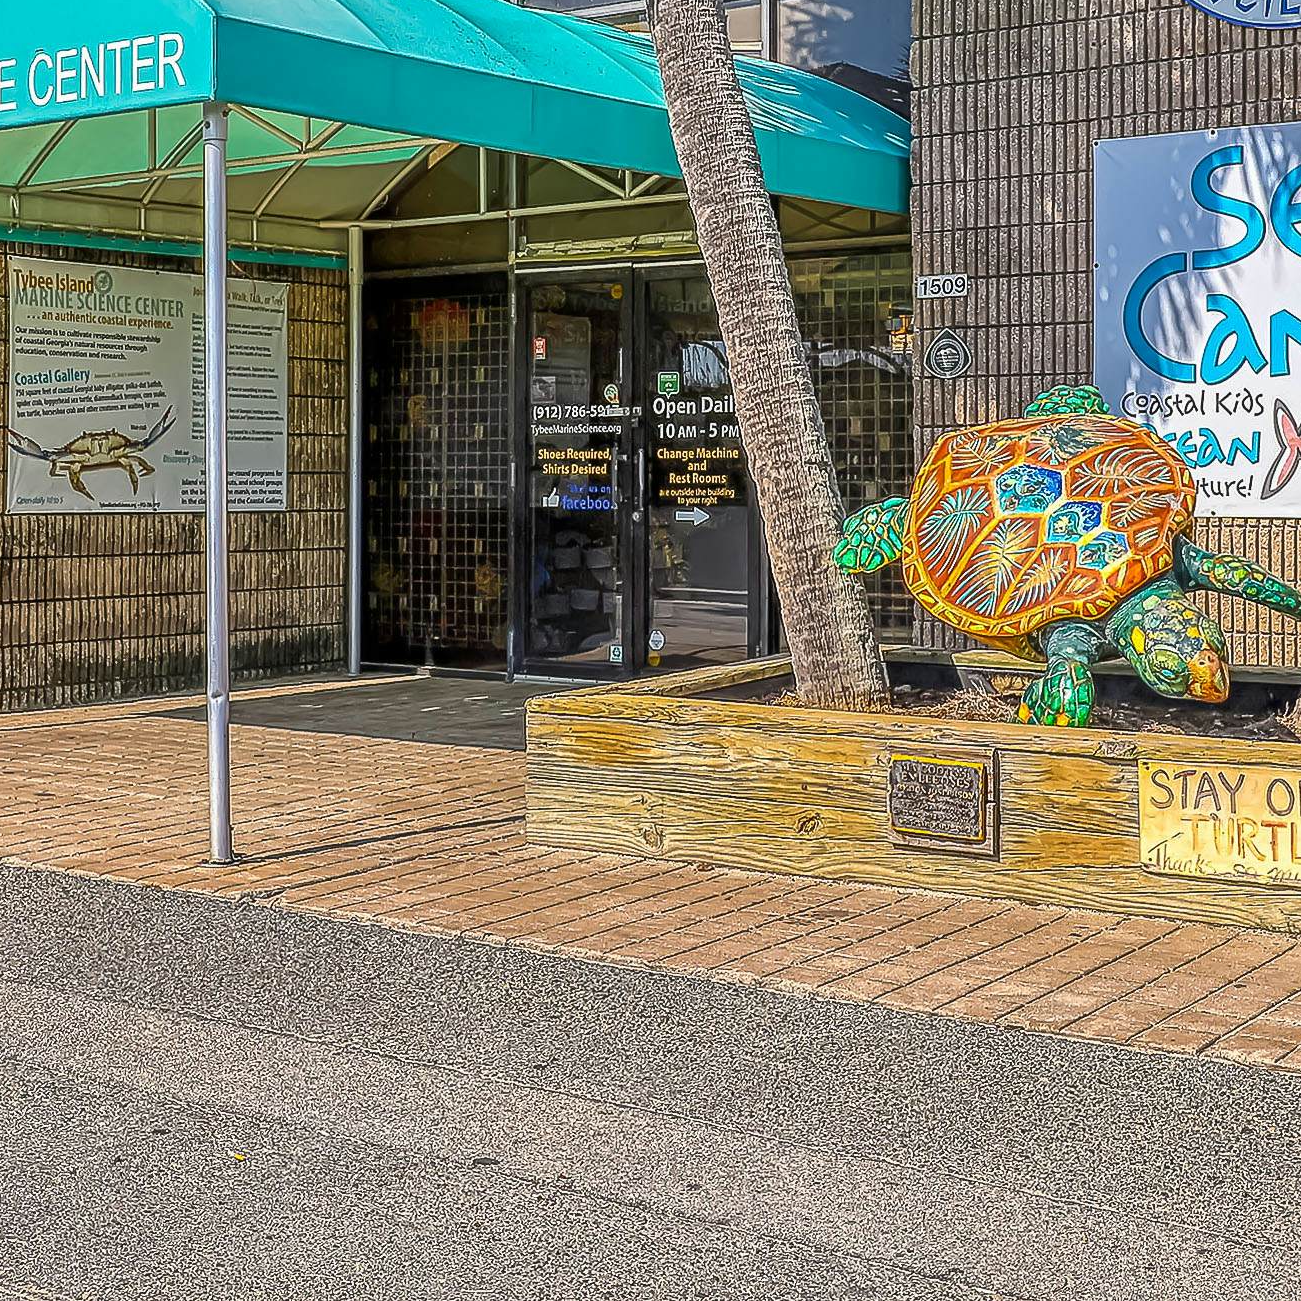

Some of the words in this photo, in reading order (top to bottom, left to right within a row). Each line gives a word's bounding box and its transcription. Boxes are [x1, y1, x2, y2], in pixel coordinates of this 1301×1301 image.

[27, 33, 185, 106] CENTER
[13, 269, 53, 291] Tybee
[56, 273, 94, 293] Island
[919, 277, 965, 295] 1509
[15, 285, 73, 309] MARINE
[77, 292, 131, 313] SCIENCE
[135, 297, 184, 317] CENTER
[55, 311, 97, 324] authentic
[98, 314, 126, 326] coastal
[128, 319, 174, 331] experience.
[67, 330, 92, 338] cultivate
[15, 347, 48, 356] education,
[49, 349, 87, 357] conservation
[125, 344, 147, 352] through
[15, 370, 52, 385] Coastal
[55, 368, 90, 384] Gallery
[653, 397, 696, 418] Open
[701, 395, 733, 413] Dail
[1121, 390, 1205, 417] Coastal
[1215, 387, 1264, 417] Kids
[533, 405, 562, 420] (912)
[531, 423, 621, 436] TybeeMarineScience.org
[657, 423, 675, 438] 10
[678, 425, 696, 438] AM
[709, 422, 717, 437] 5
[721, 425, 739, 437] PM
[538, 448, 565, 459] Shoes
[567, 448, 611, 461] Required,
[657, 447, 694, 461] Change
[696, 447, 739, 458] Machine
[543, 463, 570, 474] Shirts
[571, 463, 607, 474] Desired
[688, 460, 706, 471] and
[669, 473, 690, 483] Rest
[692, 473, 727, 483] Rooms
[671, 488, 694, 496] outside
[695, 488, 706, 496] the
[707, 488, 734, 498] building
[1196, 474, 1254, 498] ture!
[561, 495, 612, 509] faceboo
[686, 498, 700, 506] your
[701, 496, 717, 506] right
[1150, 769, 1245, 814] STAY
[1148, 832, 1217, 875] Thanks
